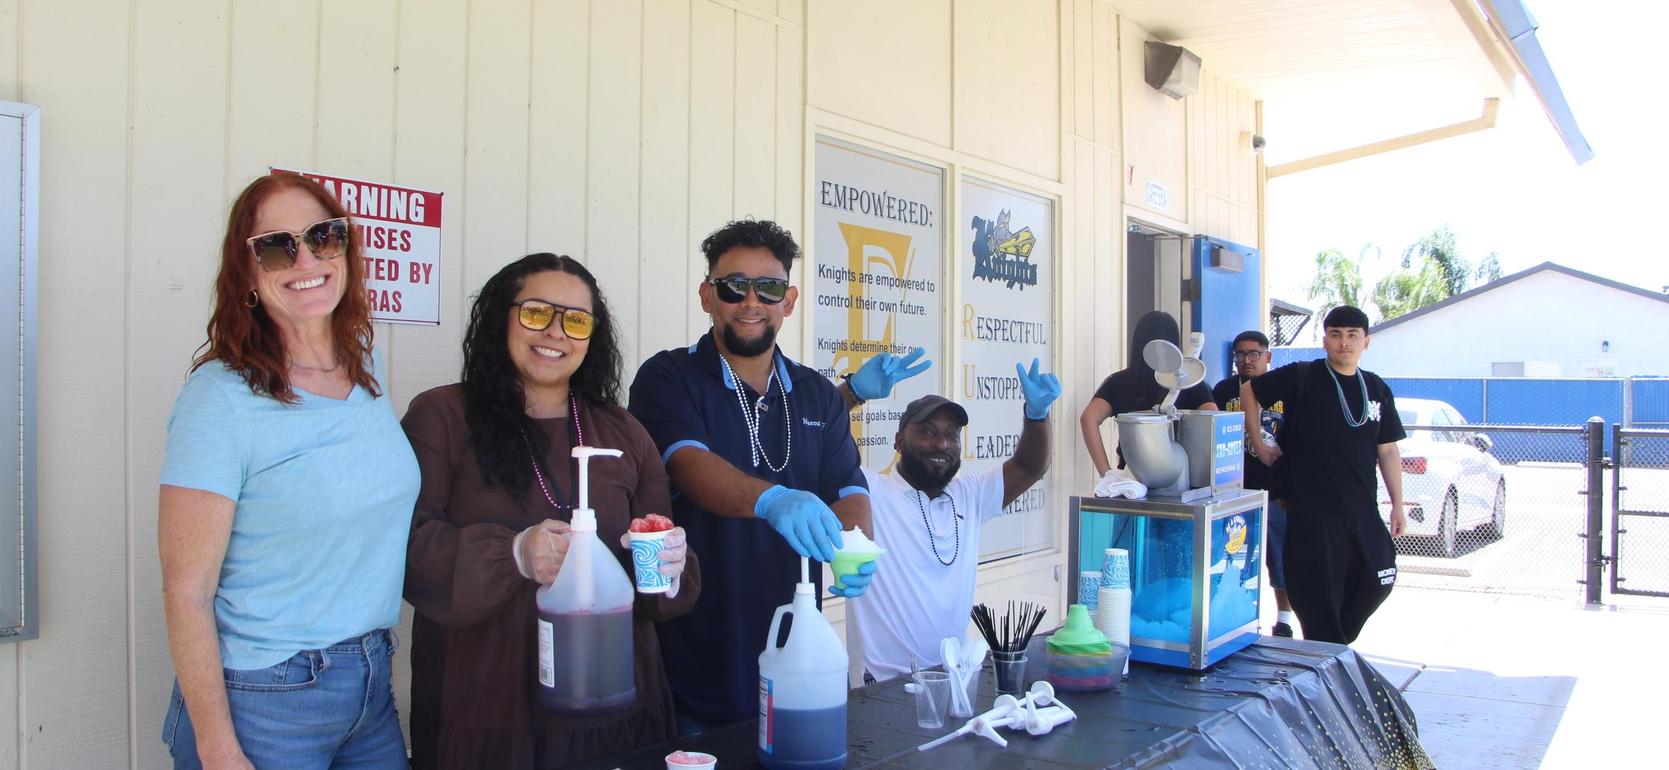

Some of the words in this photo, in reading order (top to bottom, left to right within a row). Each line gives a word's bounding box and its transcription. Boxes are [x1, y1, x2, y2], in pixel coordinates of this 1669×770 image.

[820, 181, 933, 228] EMPOWERED:
[972, 216, 1037, 291] Knights
[409, 262, 433, 284] BY
[818, 264, 856, 283] Knights
[858, 272, 873, 284] are
[876, 277, 925, 291] empowered
[927, 281, 935, 292] to
[818, 294, 853, 308] control
[856, 296, 876, 311] their
[879, 302, 897, 312] own
[900, 300, 926, 316] future.
[962, 304, 1046, 345] RESPECTFUL
[818, 338, 848, 353] Knights
[850, 339, 888, 353] determine
[890, 342, 907, 354] their
[851, 411, 863, 422] set
[866, 410, 887, 424] goals
